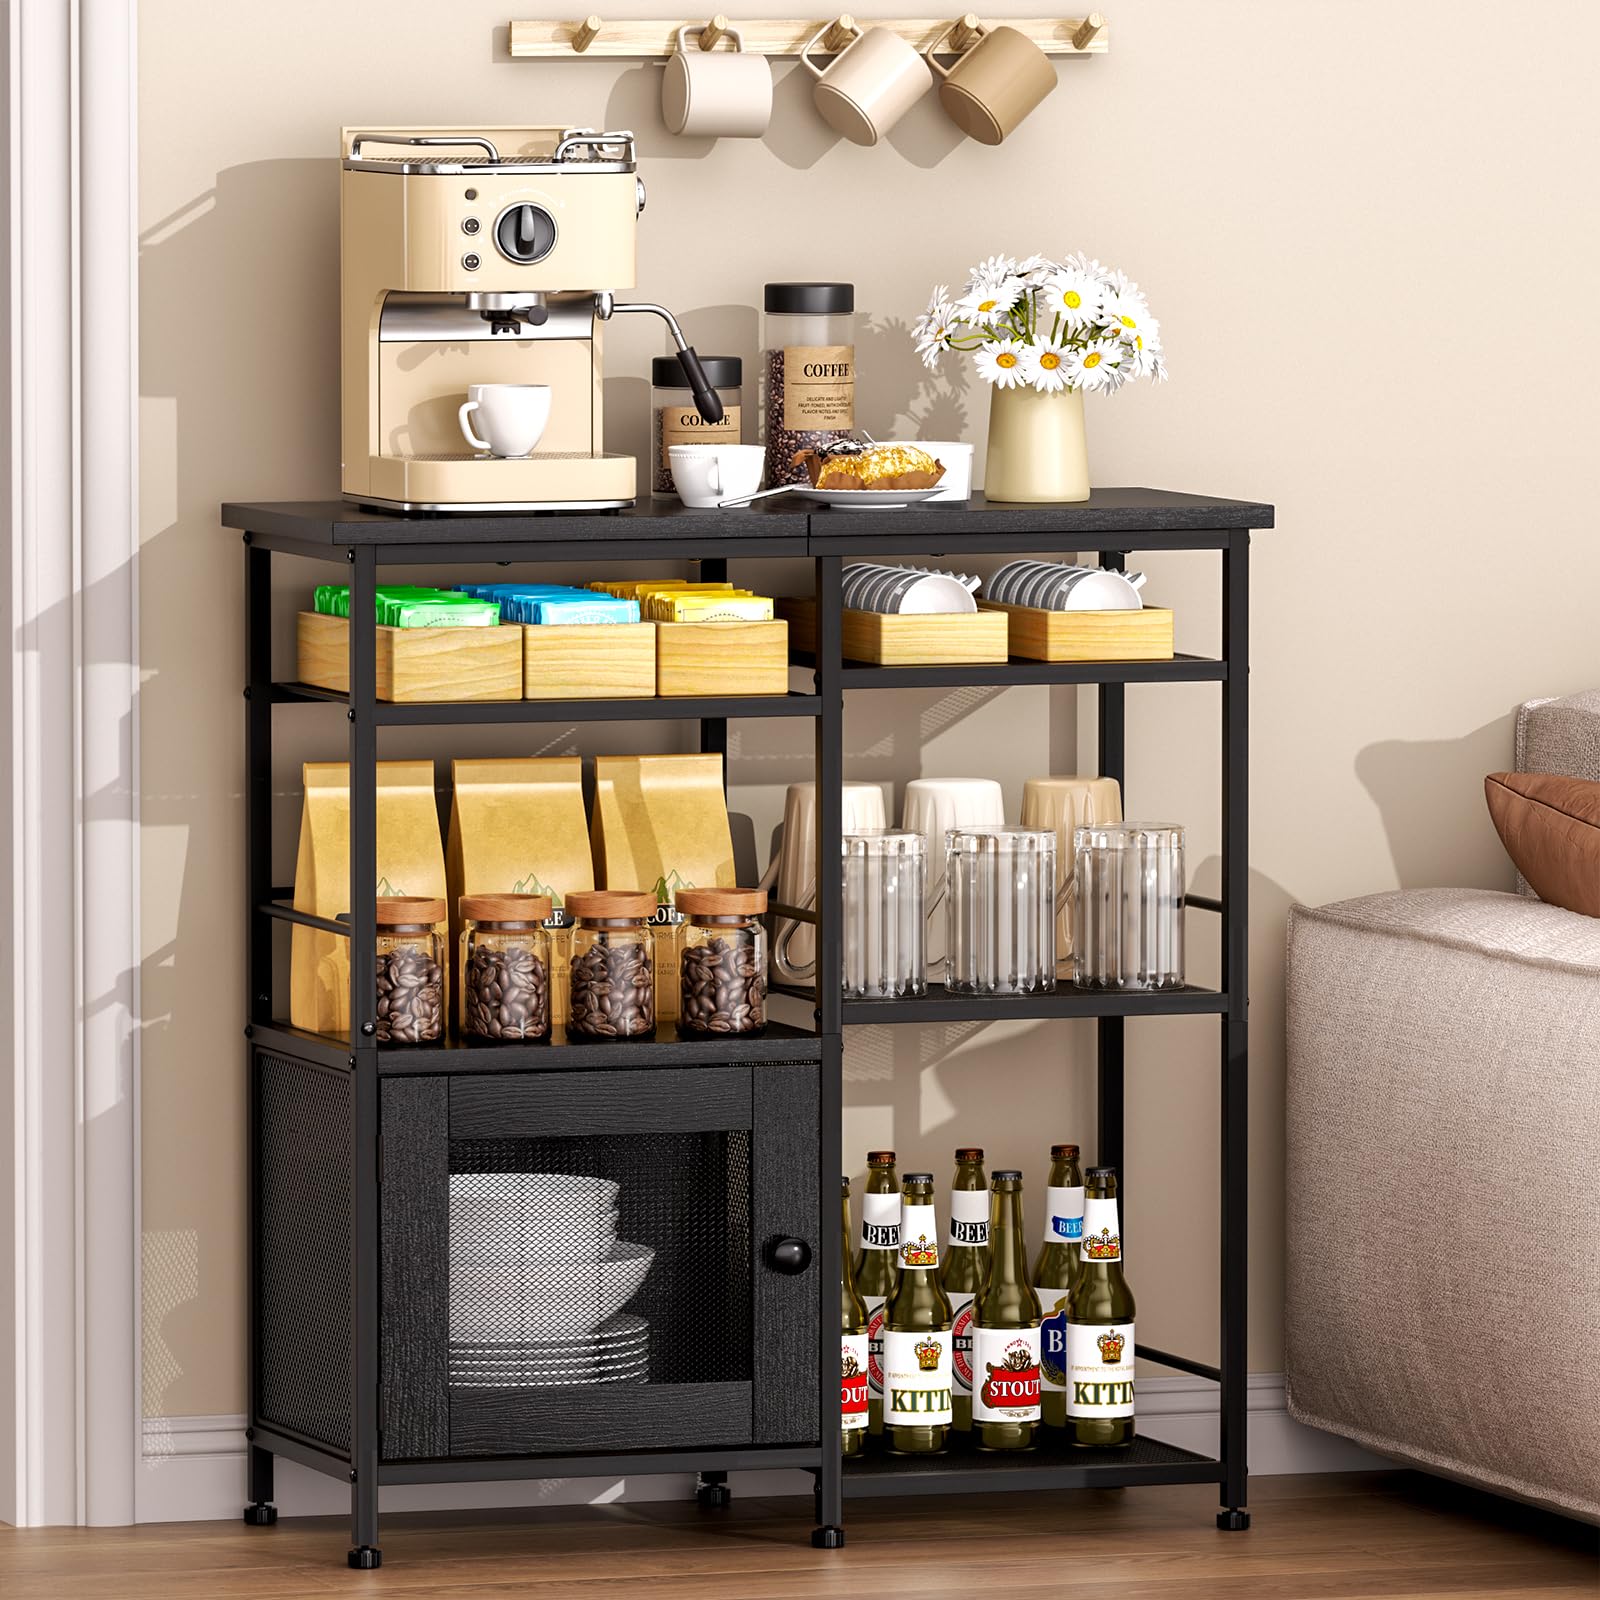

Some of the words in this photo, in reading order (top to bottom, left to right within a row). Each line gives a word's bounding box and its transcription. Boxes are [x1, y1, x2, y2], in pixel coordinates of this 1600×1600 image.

[803, 363, 850, 377] COFFEE
[680, 414, 731, 426] COFE
[867, 1224, 900, 1245] BEE
[990, 1379, 1040, 1397] STOUT
